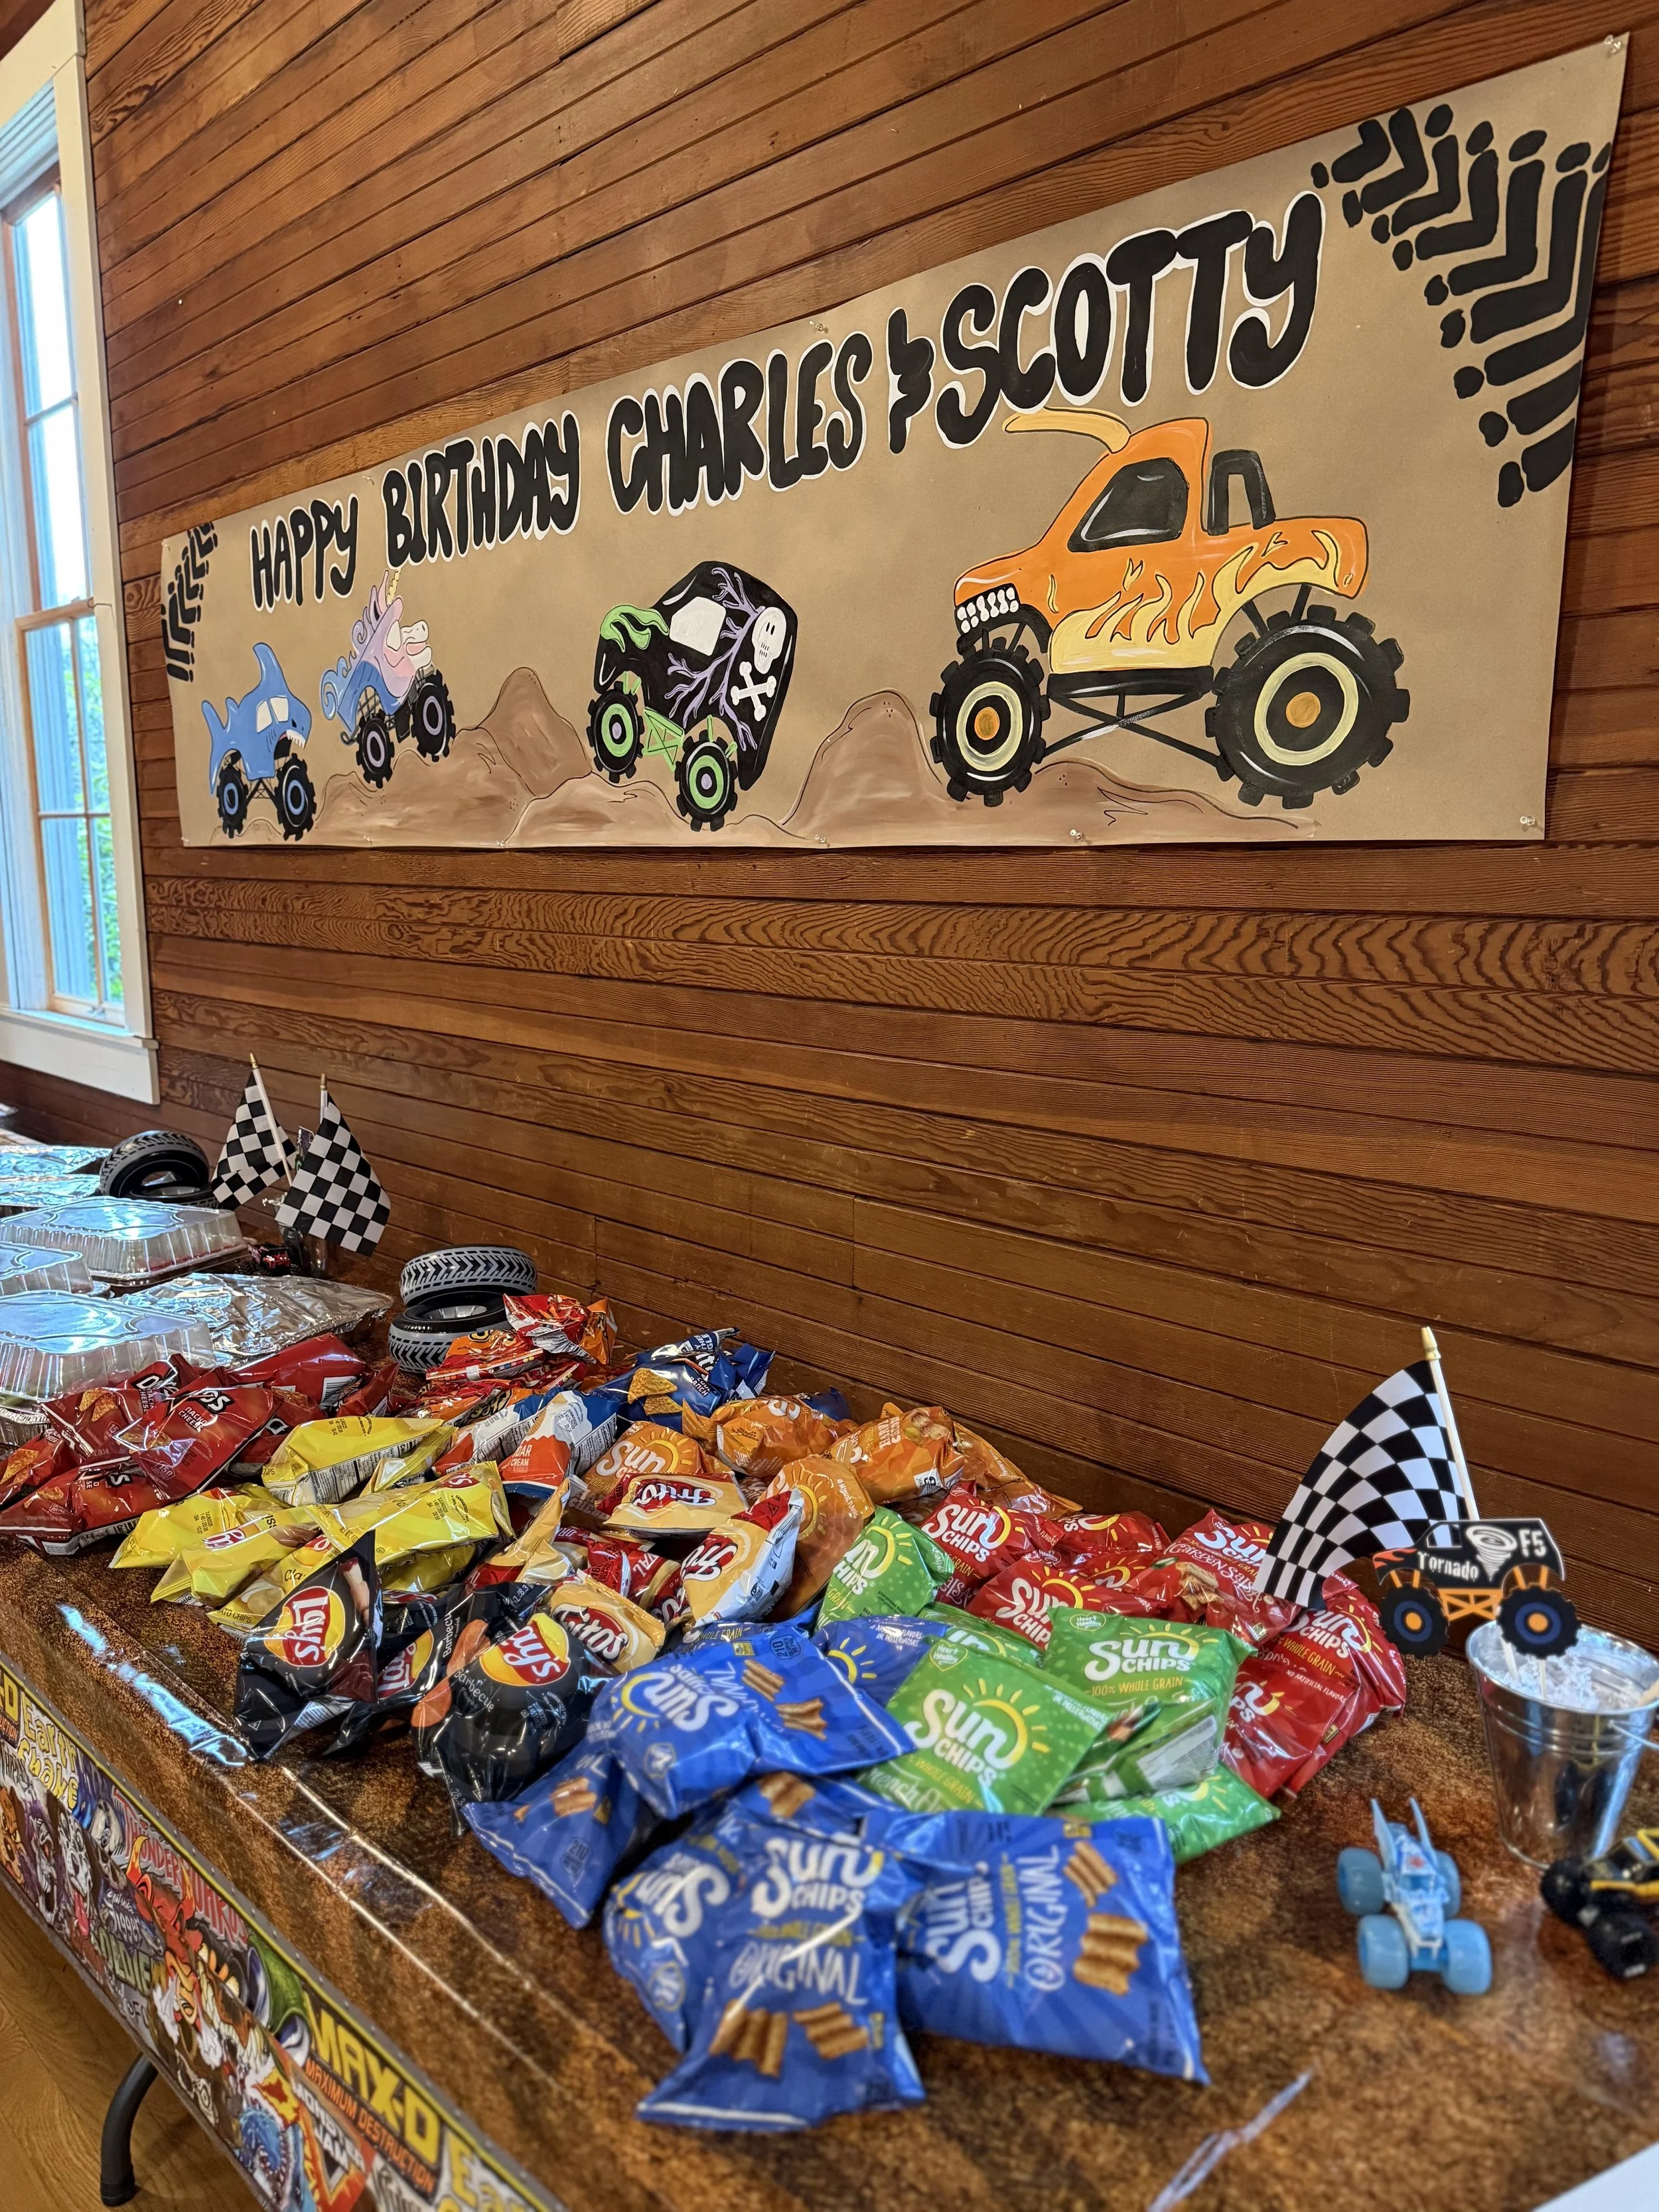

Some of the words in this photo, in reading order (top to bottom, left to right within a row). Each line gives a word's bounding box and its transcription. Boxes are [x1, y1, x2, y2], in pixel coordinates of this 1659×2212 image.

[250, 496, 358, 612] HAPPY
[382, 409, 579, 569] BIRTHDAY
[607, 332, 873, 516] CHARLES
[936, 191, 1325, 449] SCOTTY
[145, 1388, 155, 1409] NACH
[689, 1376, 709, 1397] RANCH
[109, 1424, 118, 1434] 15
[178, 1410, 204, 1433] CHEESE
[184, 1406, 208, 1426] NACHO
[158, 1463, 172, 1477] 150
[510, 1458, 530, 1467] CREAM
[596, 1440, 666, 1477] Sun
[921, 1504, 1001, 1550] Sun
[1041, 1529, 1056, 1547] FLAVORS
[1518, 1529, 1548, 1558] F5
[942, 1529, 991, 1562] CHIPS
[832, 1560, 868, 1595] HIPS
[950, 1556, 974, 1576] GRAIN
[1417, 1551, 1479, 1582] Tornado
[827, 1587, 849, 1610] GRAIN
[1134, 1595, 1153, 1613] AVORS
[232, 1611, 253, 1624] CHIPS
[284, 1595, 329, 1662] Lay's
[1013, 1613, 1052, 1651] CHIP
[1076, 1619, 1102, 1628] Healthy
[719, 1627, 743, 1642] GRAIN
[772, 1640, 788, 1658] 210
[936, 1643, 959, 1655] Heart
[1299, 1625, 1350, 1659] CHIPS
[503, 1626, 561, 1677] ay's
[933, 1651, 959, 1663] Healthy
[1084, 1639, 1194, 1681] Sun
[1121, 1658, 1190, 1674] CHIPS
[1284, 1639, 1308, 1659] WHOLE
[1307, 1653, 1336, 1676] GRAIN
[454, 1668, 494, 1712] Barbecue
[670, 1663, 715, 1695] CHIPS
[1091, 1684, 1116, 1697] 100%
[1119, 1679, 1149, 1693] WHOLE
[1153, 1676, 1183, 1690] GRAIN
[1295, 1673, 1323, 1692] ARTIFICIAL
[1323, 1687, 1348, 1704] FLAVORS
[643, 1672, 739, 1733] Sun
[22, 1692, 76, 1773] Earth
[904, 1689, 1011, 1770] Sun
[933, 1737, 996, 1787] CHIPS
[914, 1757, 946, 1784] WHOLE
[944, 1775, 976, 1804] GRAIN
[569, 1839, 589, 1857] 210
[751, 1837, 871, 1919] Sun
[636, 1864, 730, 1937] Sun
[792, 1883, 865, 1913] CHIPS
[925, 1881, 1001, 1983] Sun
[1017, 1844, 1068, 1991] ORIGINAL
[730, 1941, 868, 2006] ORIGINAL
[305, 1992, 439, 2166] MAX-D
[305, 2058, 357, 2122] MAXIMUM
[291, 2076, 366, 2174] MONSTER
[315, 2125, 348, 2174] JAM
[359, 2107, 437, 2195] DESTRUCTION
